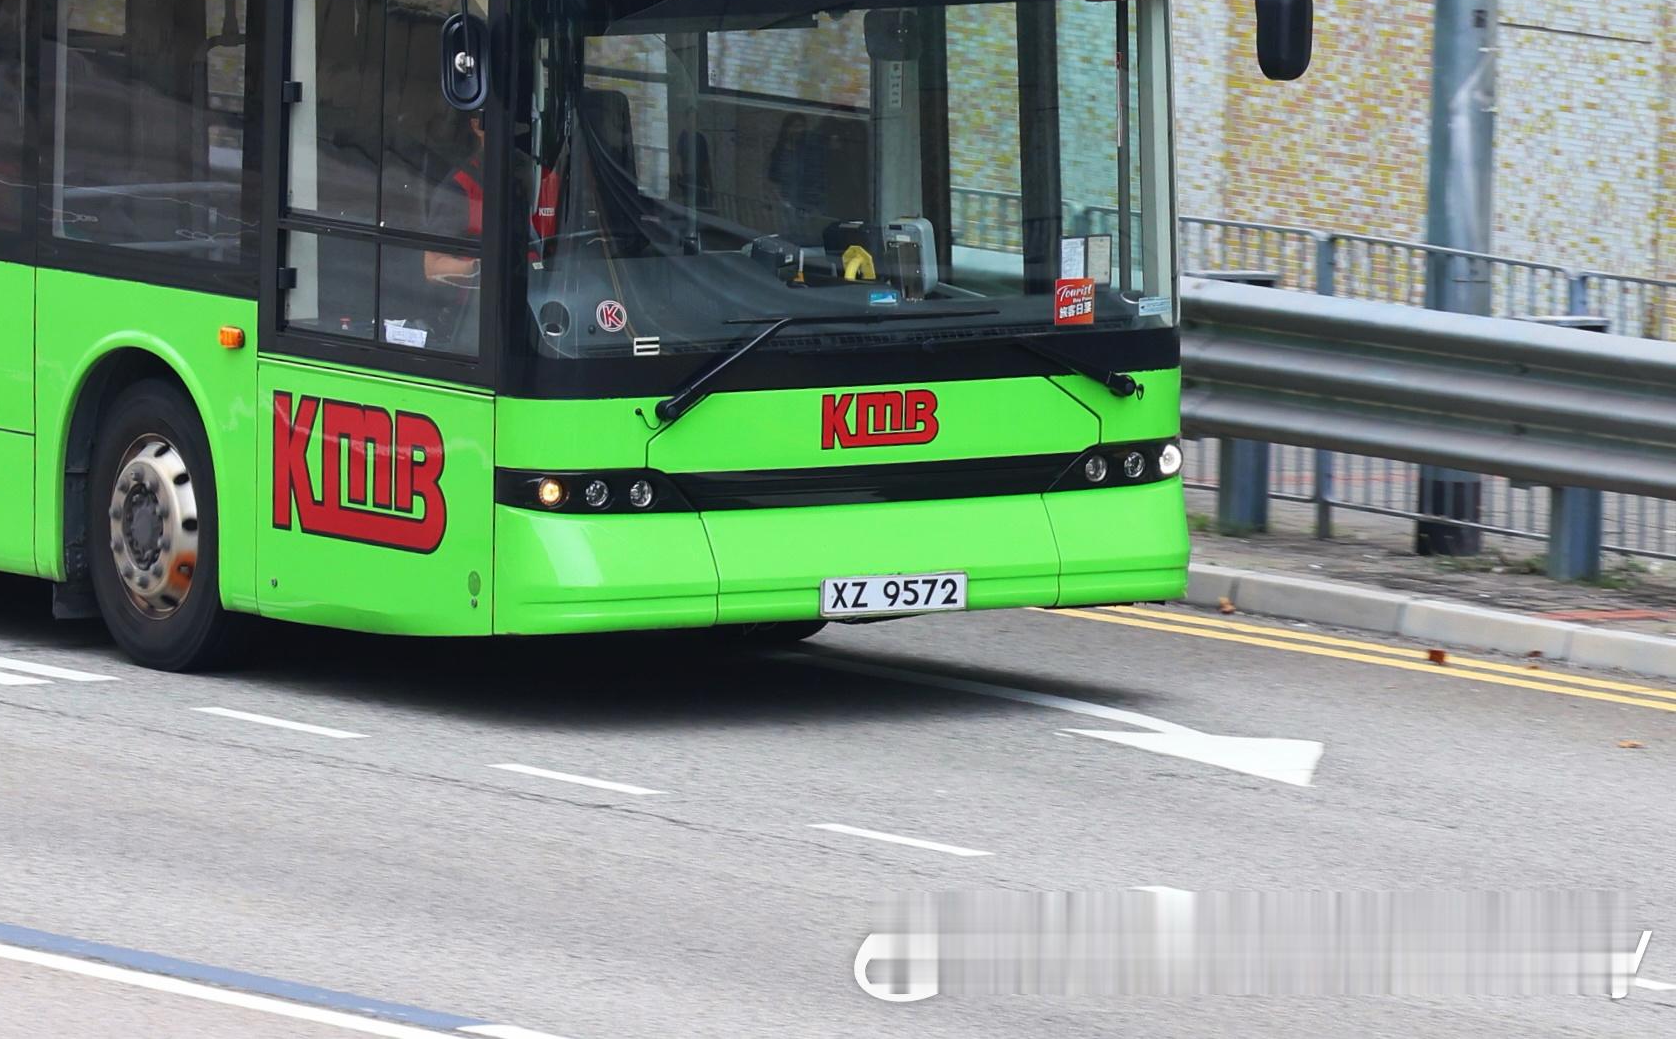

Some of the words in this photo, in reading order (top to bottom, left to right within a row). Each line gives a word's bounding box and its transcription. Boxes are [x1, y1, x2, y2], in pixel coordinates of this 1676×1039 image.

[1057, 283, 1093, 302] Tourist
[821, 389, 939, 449] KMB
[273, 389, 447, 555] KMB
[831, 581, 868, 609] XZ
[883, 578, 958, 607] 9572
